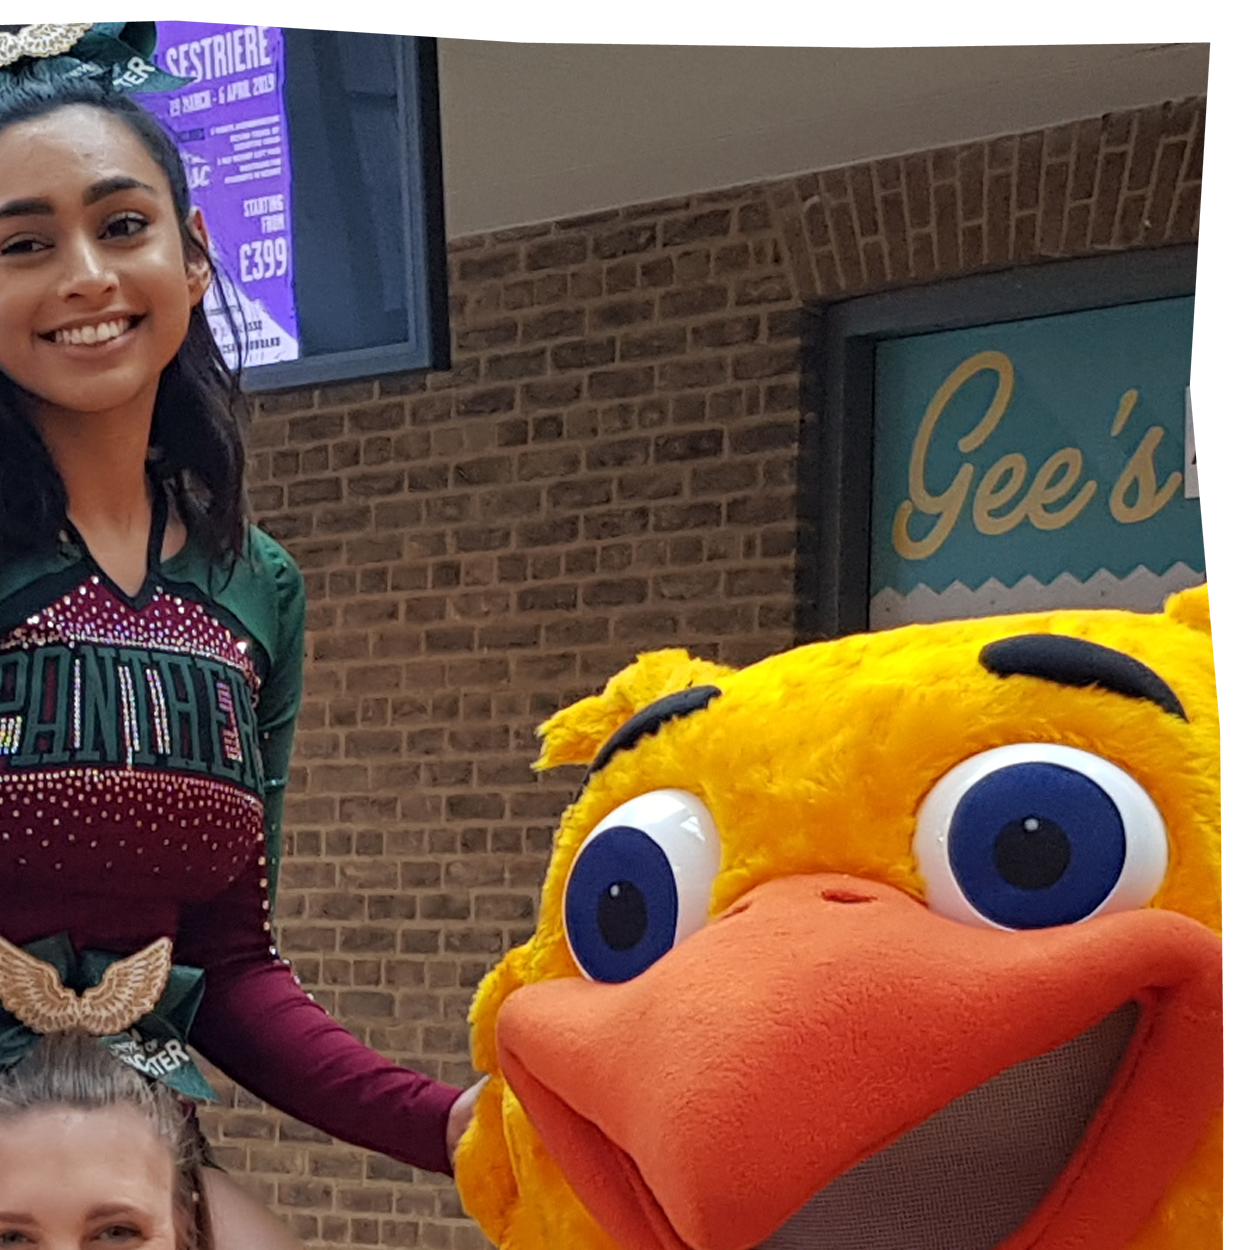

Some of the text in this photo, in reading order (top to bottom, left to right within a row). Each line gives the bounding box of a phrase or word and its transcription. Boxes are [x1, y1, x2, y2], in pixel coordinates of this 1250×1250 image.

[166, 22, 271, 83] SESTRIERE
[227, 80, 251, 102] APRIL
[244, 194, 283, 217] STARTING
[261, 213, 284, 233] FROM
[240, 237, 287, 282] £399
[892, 350, 1182, 560] Gee's
[1191, 413, 1228, 466] A
